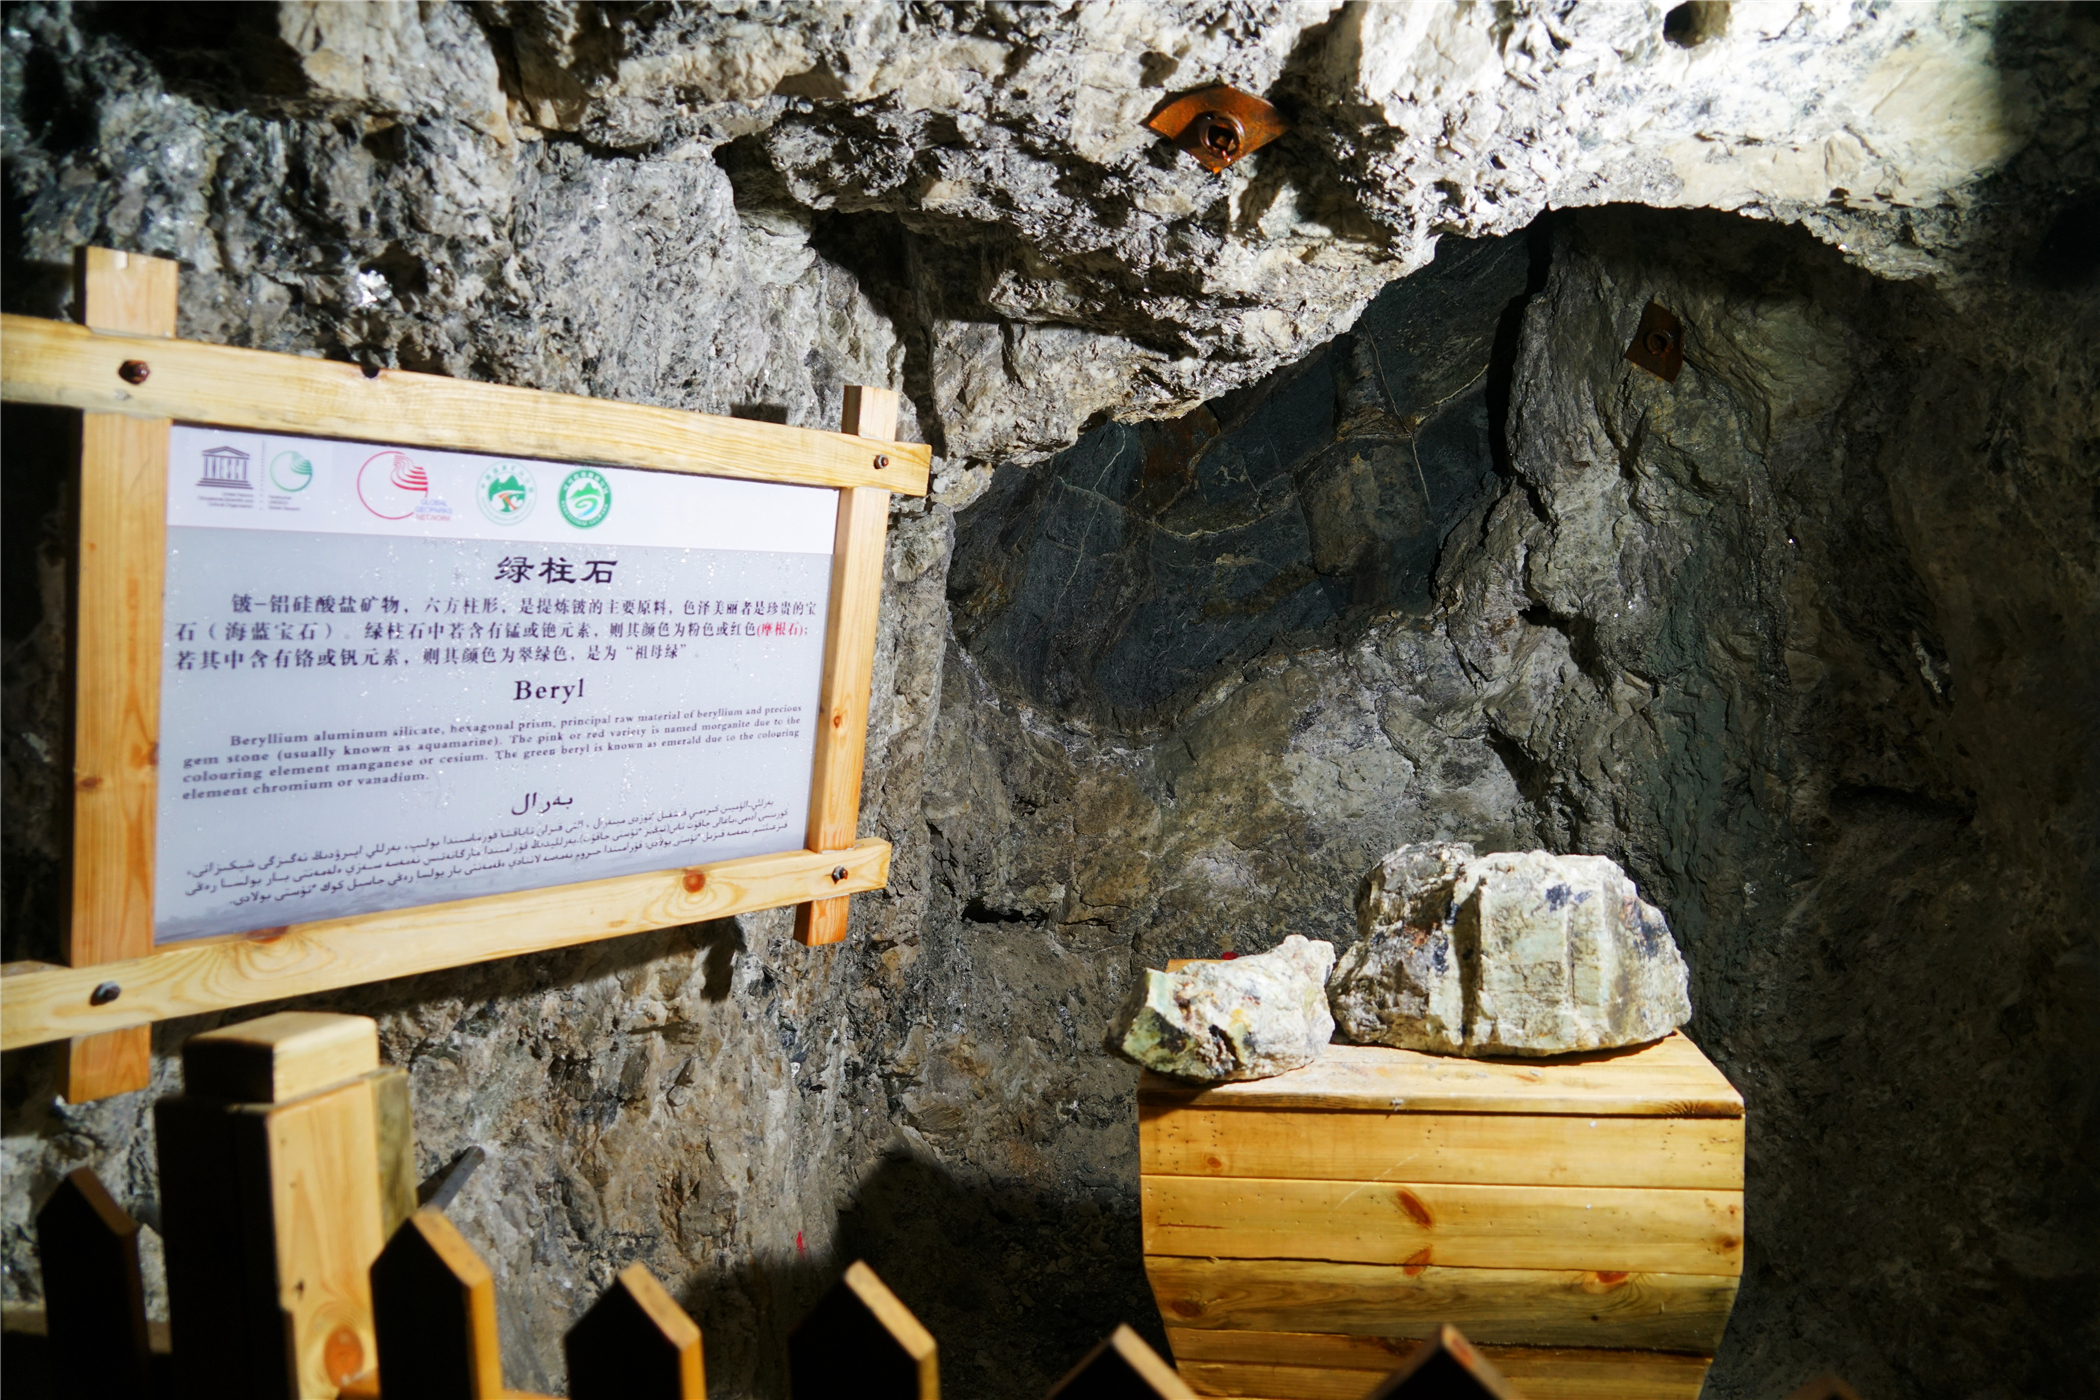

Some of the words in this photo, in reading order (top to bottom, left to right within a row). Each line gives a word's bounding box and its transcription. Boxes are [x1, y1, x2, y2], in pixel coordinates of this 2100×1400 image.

[494, 556, 618, 584] 绿柱石
[513, 678, 584, 704] Beryl
[183, 757, 219, 770] gem
[227, 754, 269, 763] stone
[277, 746, 336, 761] (usually
[344, 745, 391, 756] known
[398, 744, 411, 752] as
[509, 734, 533, 744] The
[538, 732, 563, 745] pink
[586, 729, 605, 739] red
[610, 727, 646, 738] variety
[651, 725, 660, 734] is
[664, 723, 697, 734] named
[701, 720, 750, 732] morganite
[754, 718, 770, 727] due
[787, 716, 801, 725] the
[230, 733, 308, 748] Beryllium
[314, 729, 388, 741] aluminum
[393, 726, 445, 737] silicate,
[450, 720, 514, 734] hexagonal
[518, 719, 556, 732] prism,
[560, 715, 611, 729] principal
[638, 710, 681, 722] material
[683, 710, 695, 719] of
[697, 708, 743, 720] beryllium
[745, 706, 762, 715] and
[764, 704, 802, 716] precious
[182, 768, 263, 783] colouring
[269, 764, 330, 777] element
[336, 759, 413, 772] manganese
[439, 753, 488, 764] cesium.
[495, 749, 517, 760] The
[523, 749, 556, 760] green
[561, 744, 590, 756] beryl
[594, 743, 603, 752] is
[607, 742, 643, 751] known
[661, 735, 701, 747] emerald
[705, 735, 722, 743] due
[739, 732, 754, 741] the
[757, 729, 800, 739] colouring
[182, 787, 248, 800] element
[252, 779, 333, 794] chromium
[337, 779, 353, 787] or
[357, 772, 429, 785] vanadium.
